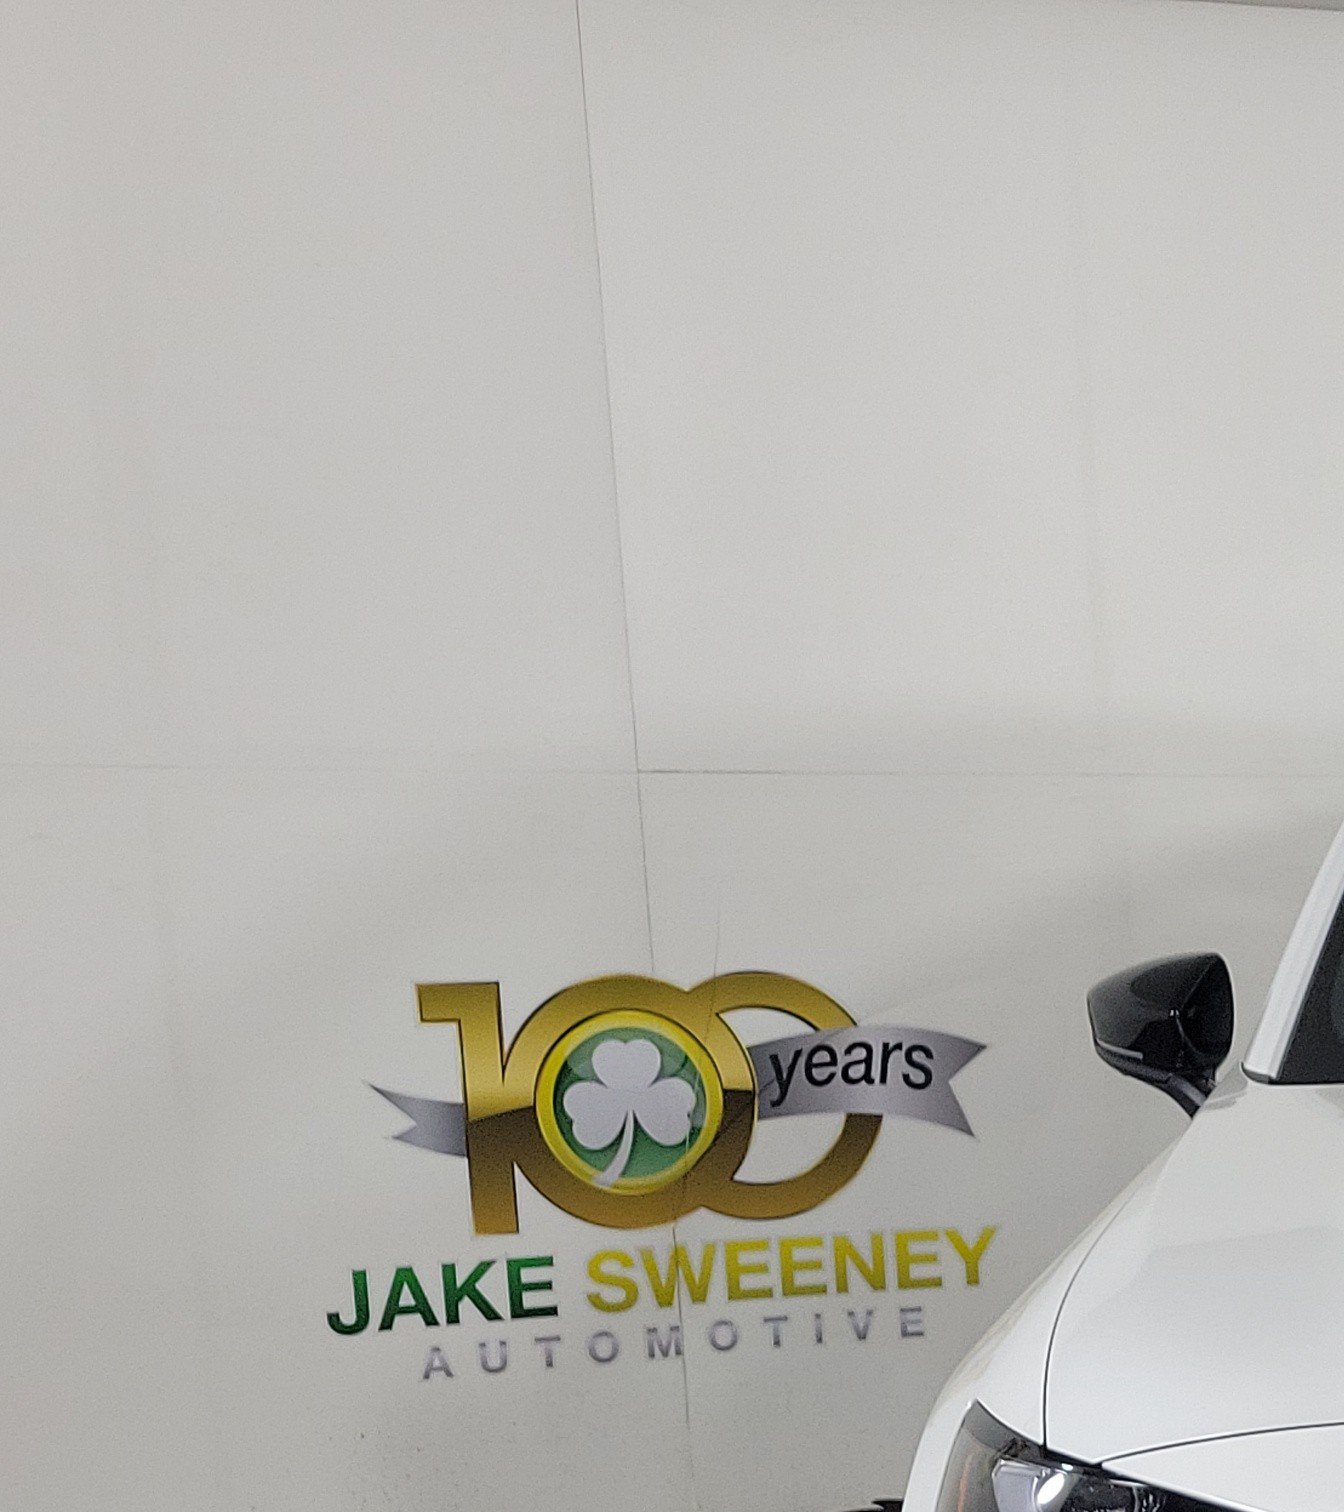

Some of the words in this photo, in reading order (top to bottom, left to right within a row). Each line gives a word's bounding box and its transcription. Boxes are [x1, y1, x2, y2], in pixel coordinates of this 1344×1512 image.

[414, 970, 884, 1236] 100
[768, 1038, 935, 1108] years
[326, 1255, 560, 1337] JAKE
[585, 1226, 998, 1314] SWEENEY
[421, 1305, 926, 1381] AUTOMOTIVE
